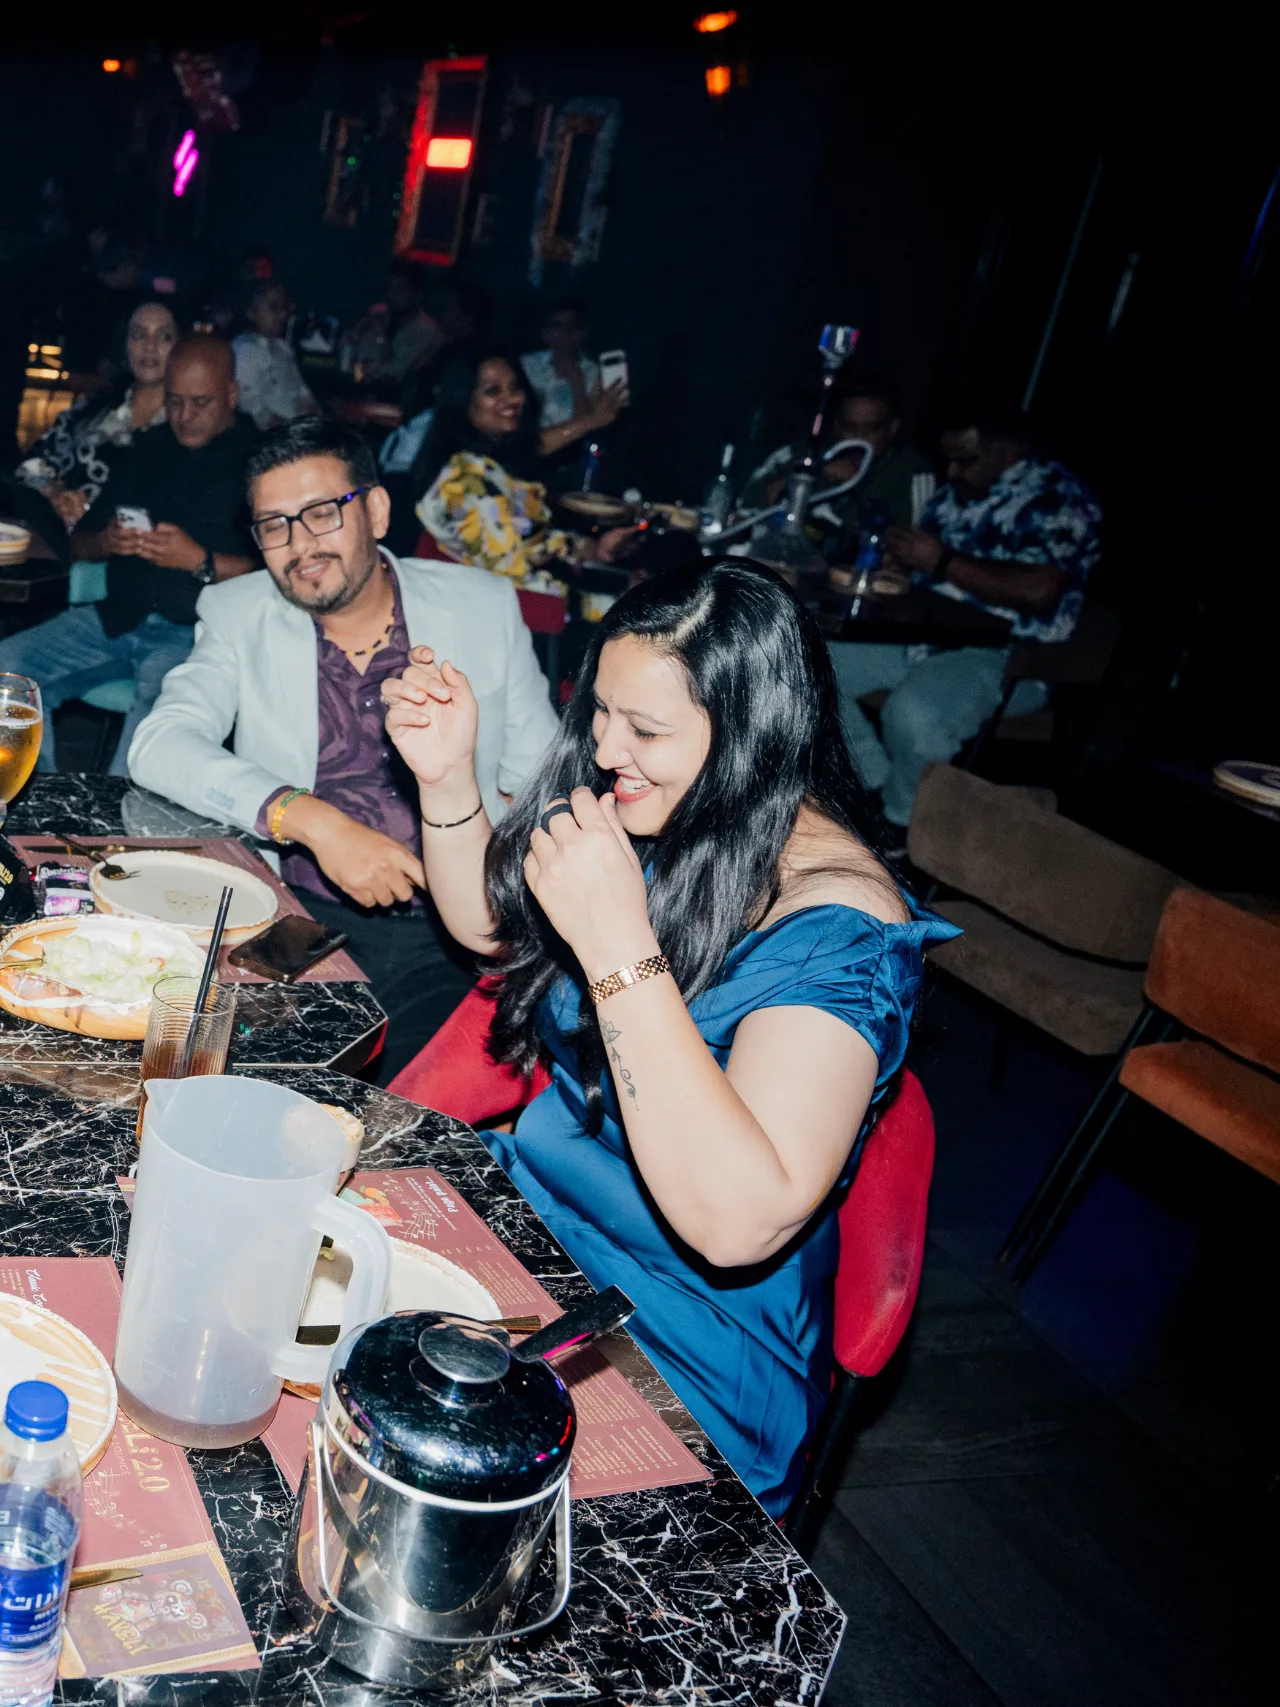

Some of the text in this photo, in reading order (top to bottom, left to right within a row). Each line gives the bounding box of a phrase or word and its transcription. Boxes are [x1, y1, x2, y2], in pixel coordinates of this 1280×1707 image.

[22, 1268, 41, 1292] Classic
[112, 1442, 130, 1477] LOUNGE
[131, 1457, 171, 1493] 2.0
[93, 1601, 149, 1656] HAVELI
